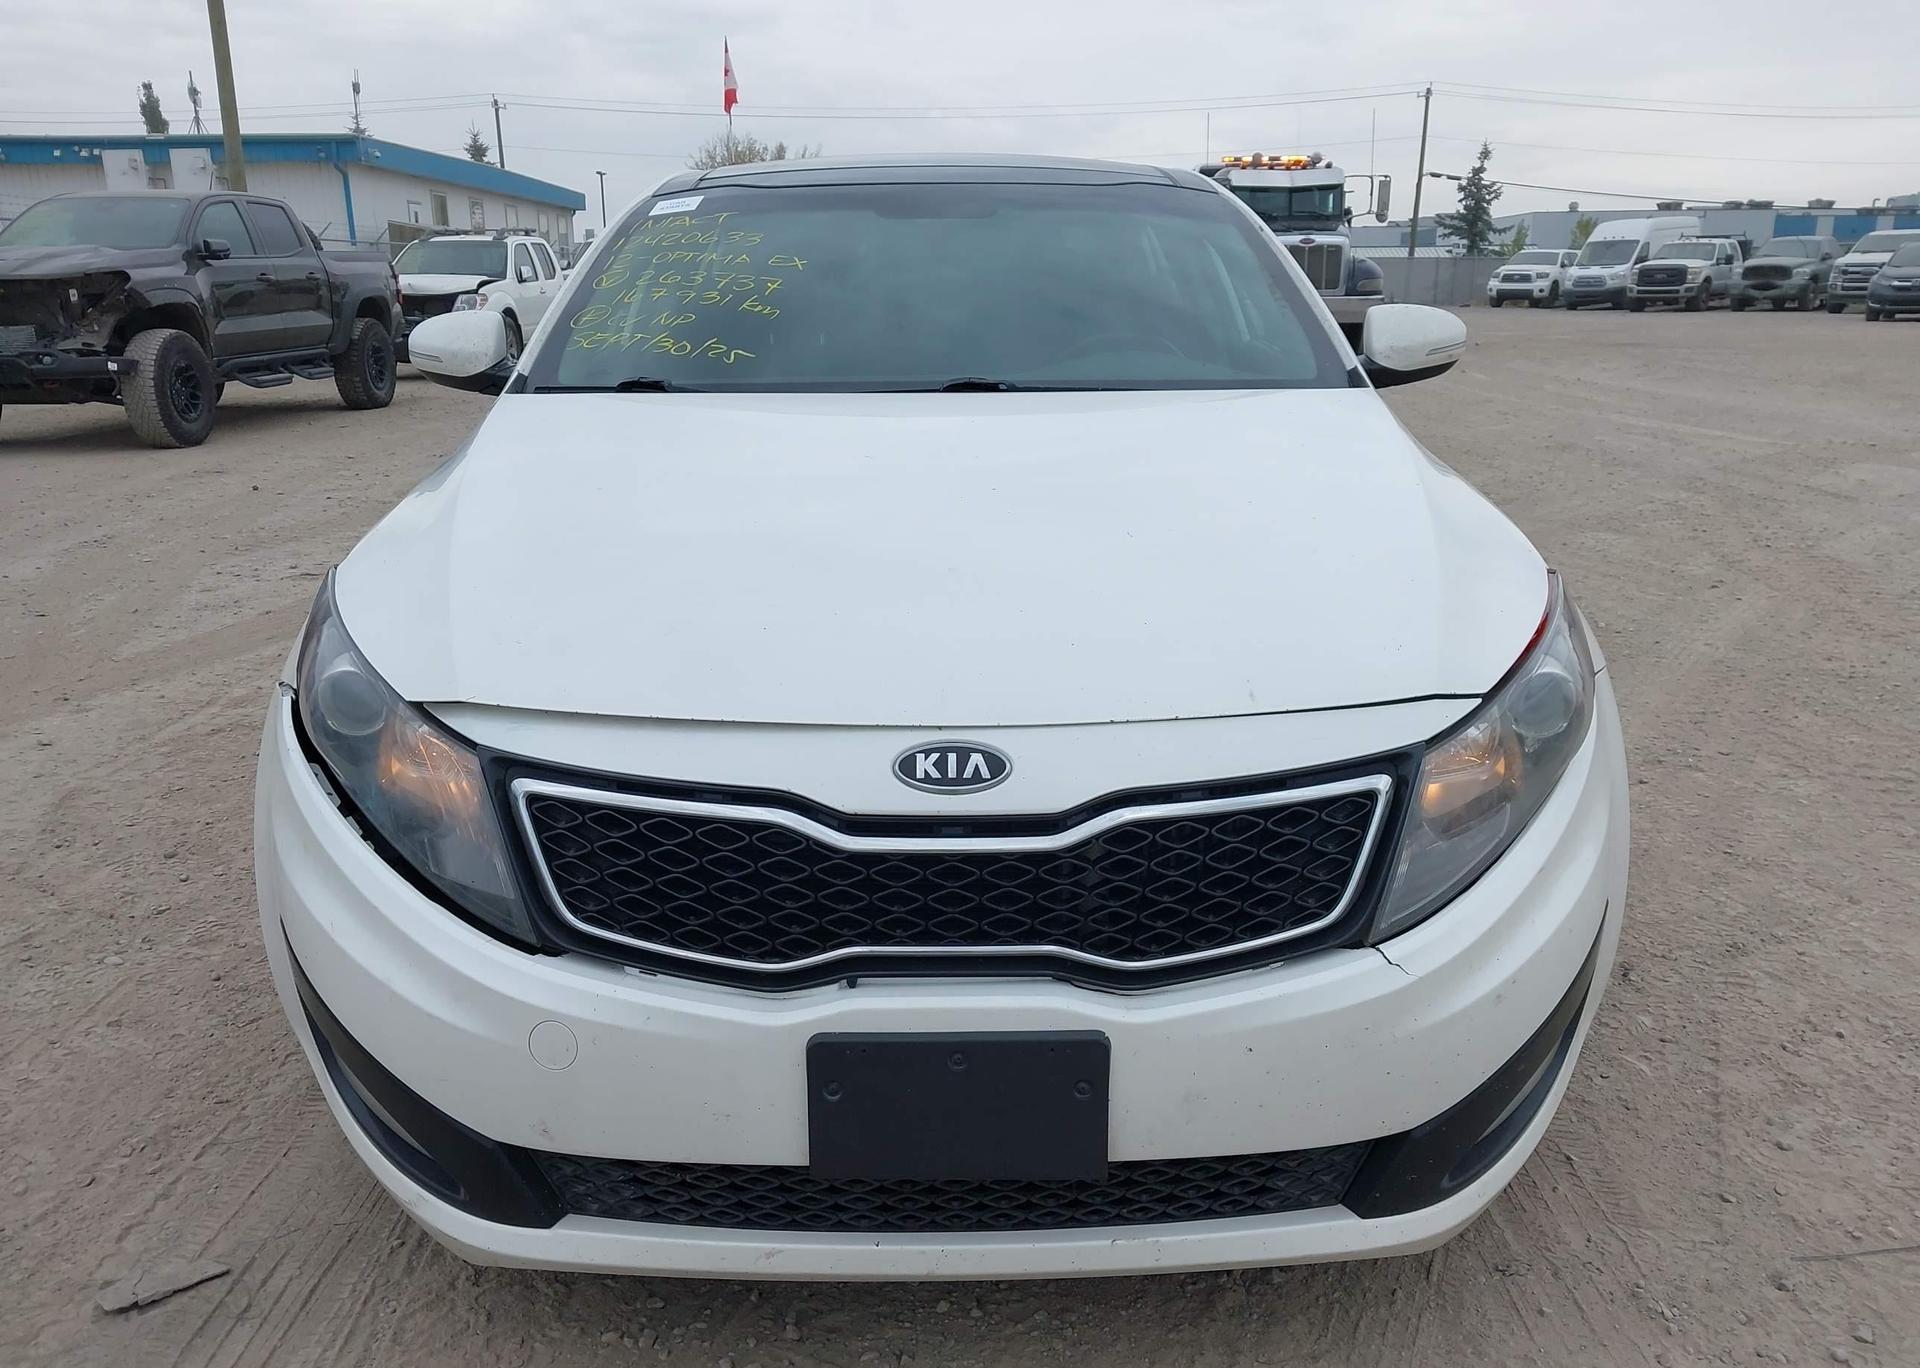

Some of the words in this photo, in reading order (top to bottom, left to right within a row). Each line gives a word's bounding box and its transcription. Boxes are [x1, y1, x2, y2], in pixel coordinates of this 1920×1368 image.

[629, 211, 740, 234] INTACT
[768, 254, 808, 271] EX
[635, 270, 785, 296] 263737
[651, 311, 696, 328] NP
[915, 752, 991, 778] KIA
